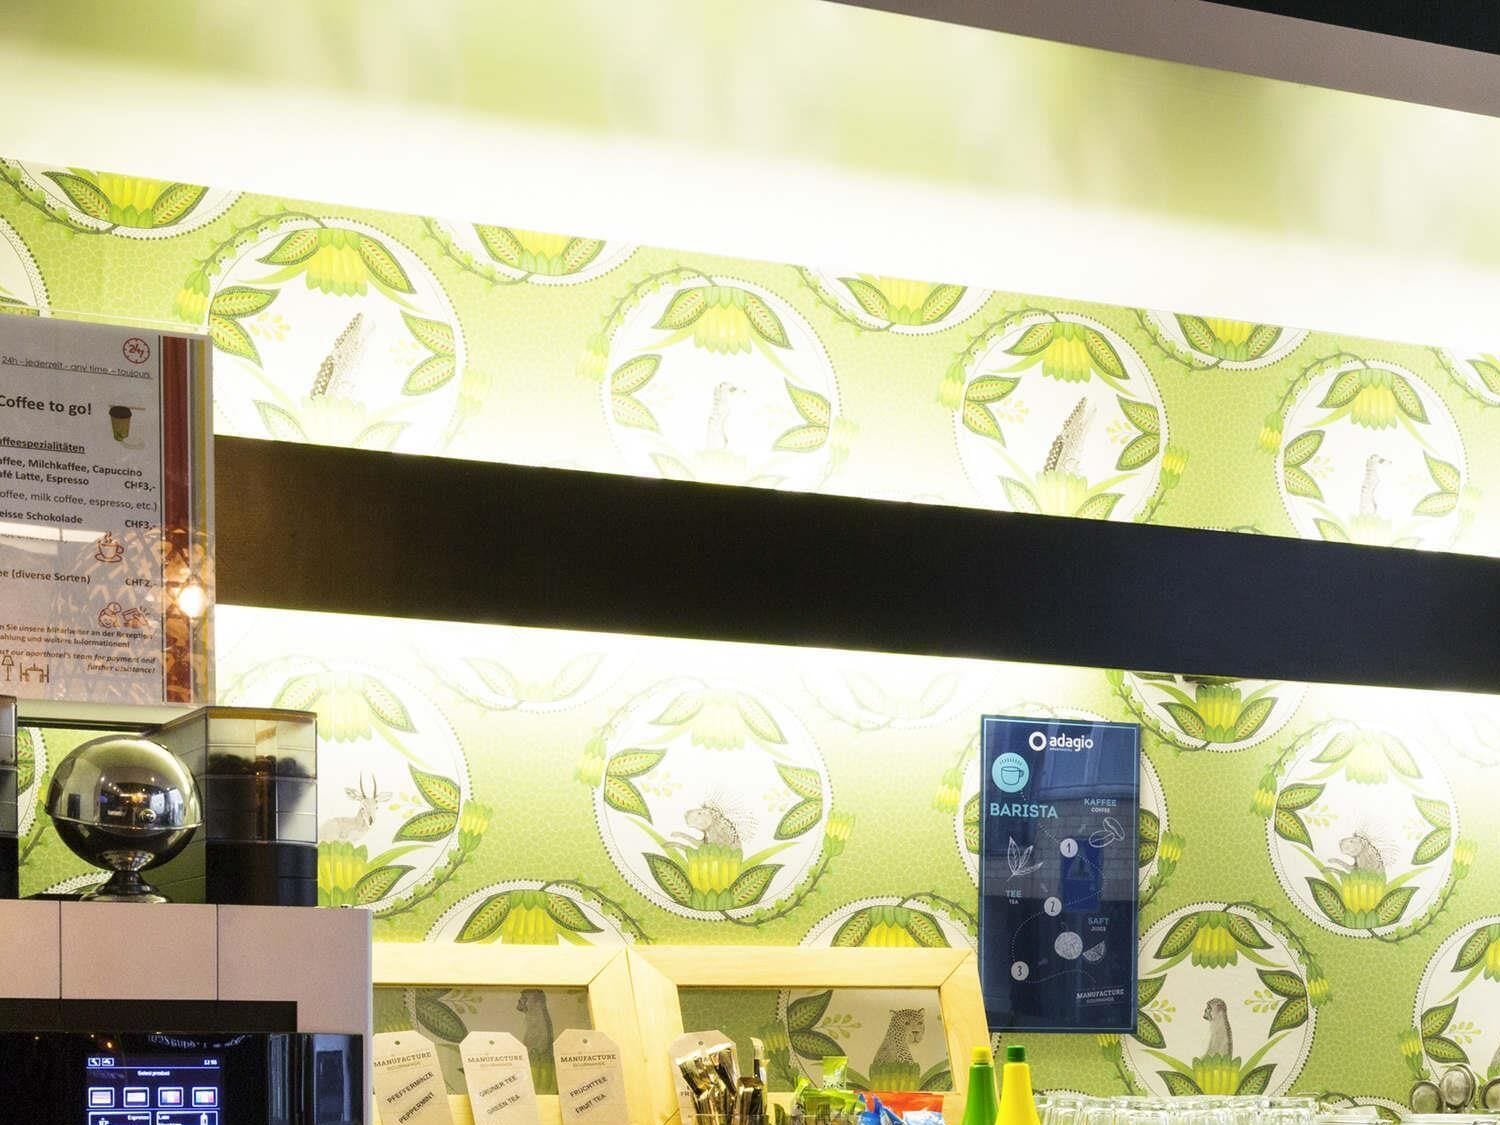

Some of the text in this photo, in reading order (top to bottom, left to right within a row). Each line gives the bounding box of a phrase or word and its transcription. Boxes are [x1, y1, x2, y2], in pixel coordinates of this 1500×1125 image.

[0, 395, 92, 416] Coffee to go!
[28, 459, 90, 474] Milchkaffee,
[92, 465, 143, 478] Capuccino
[15, 471, 43, 483] Latte,
[46, 474, 90, 487] Espresso
[30, 493, 50, 503] milk
[53, 494, 87, 506] coffee,
[89, 498, 134, 511] espresso,
[136, 500, 158, 512] etc.)
[26, 511, 84, 525] Schokolade
[11, 569, 51, 582] (diverse
[54, 573, 91, 584] Sorten)
[1049, 734, 1094, 752] adagio
[990, 802, 1059, 819] BARISTA
[1084, 798, 1117, 808] KAFFEE
[1005, 889, 1022, 899] TEE
[1087, 917, 1110, 926] SAFT
[1076, 988, 1125, 1000] MANUFACTURE
[374, 1052, 432, 1067] MANUFACTURE
[467, 1055, 523, 1063] MANUFACTURE
[560, 1054, 616, 1063] MANUFACTURE
[398, 1092, 434, 1124] PEPPERMINT
